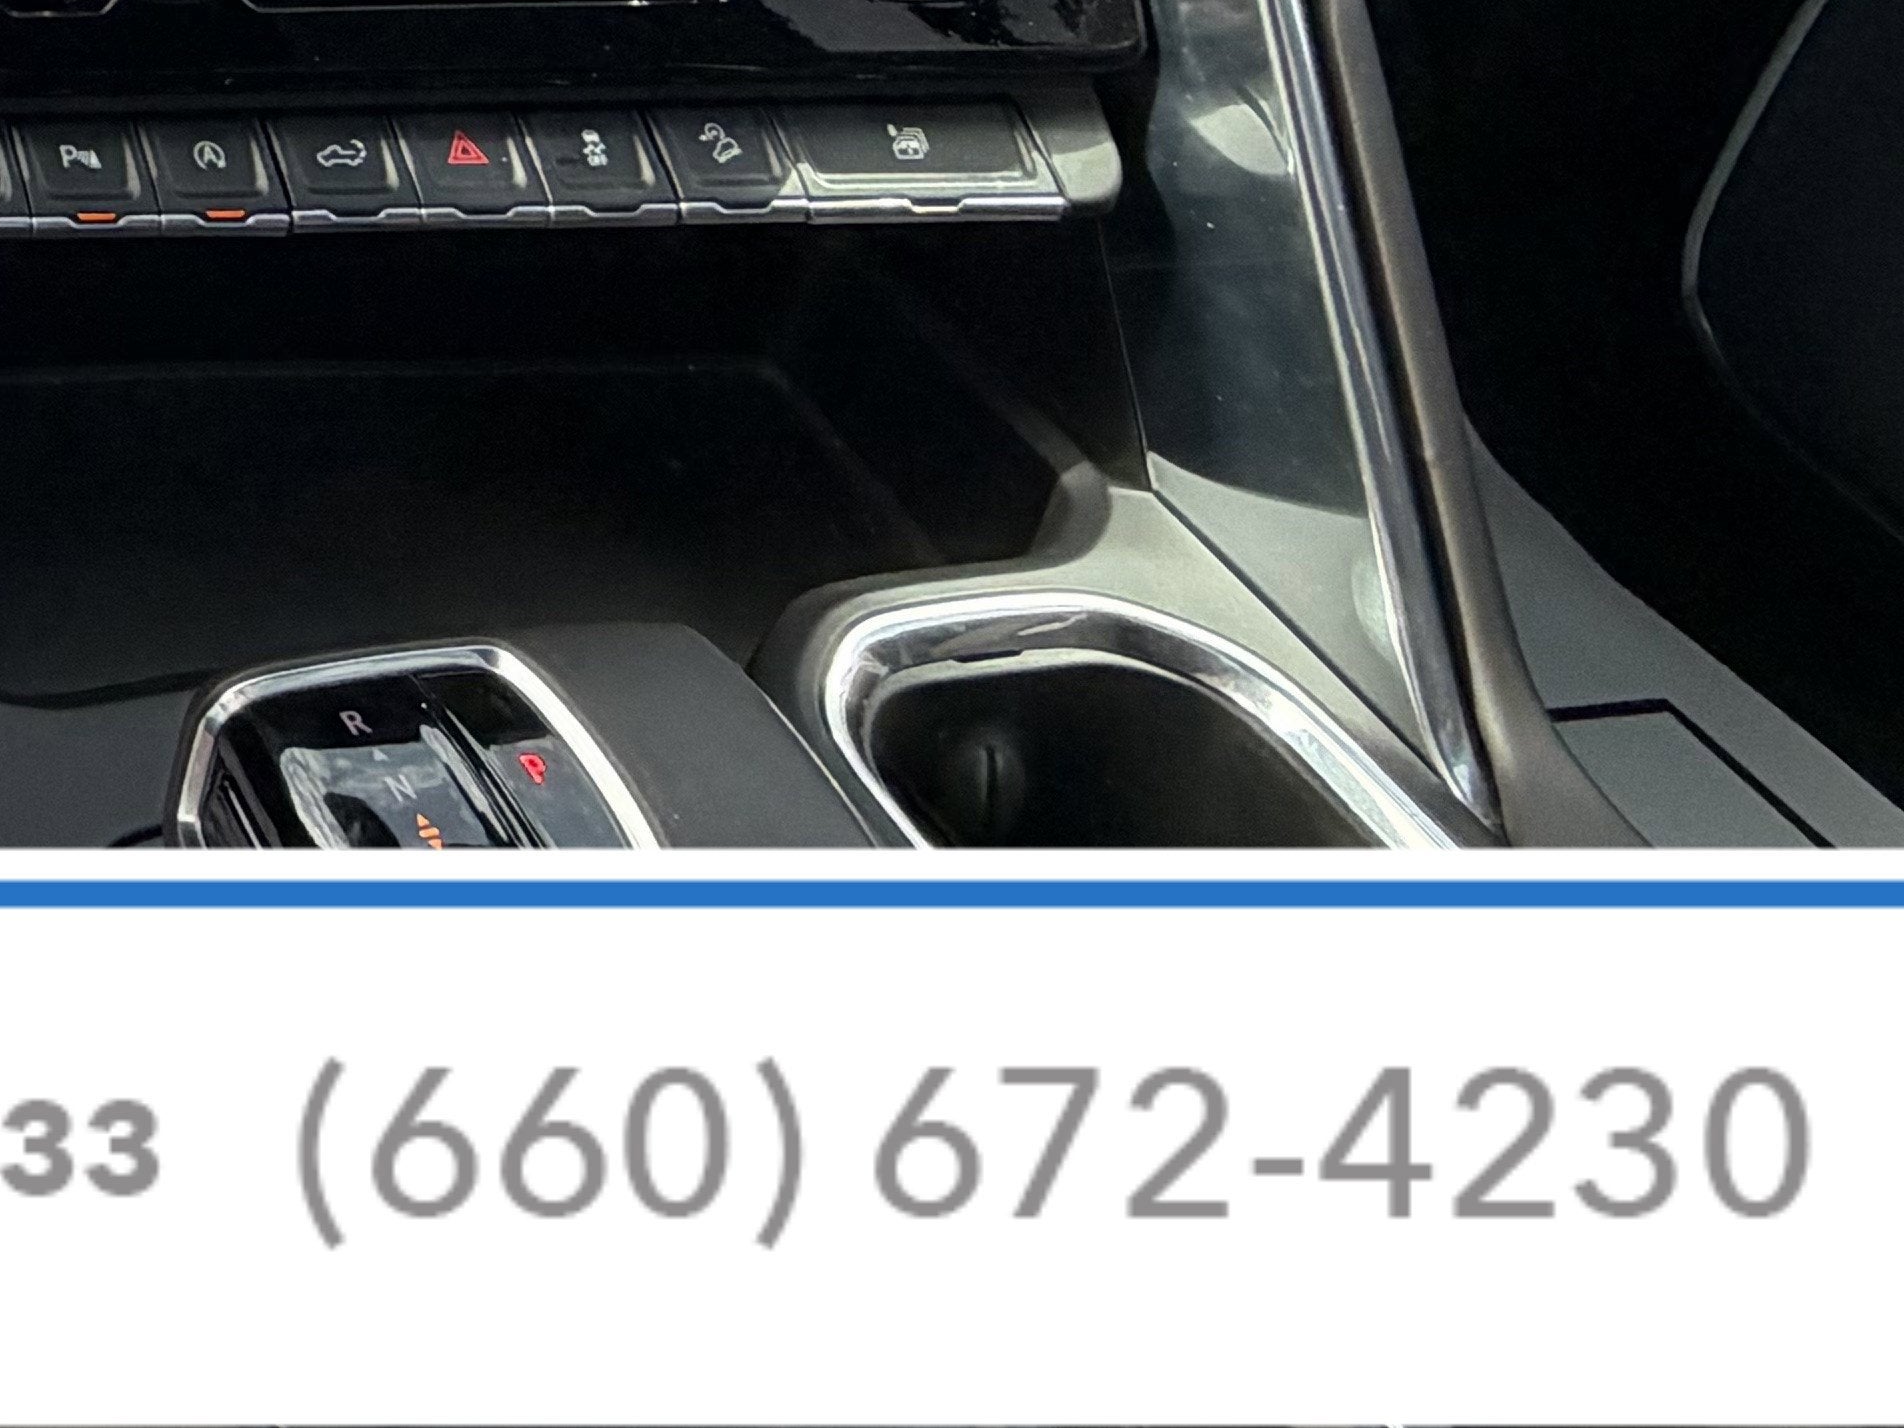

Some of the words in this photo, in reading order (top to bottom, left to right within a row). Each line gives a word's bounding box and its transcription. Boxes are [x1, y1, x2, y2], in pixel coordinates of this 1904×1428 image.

[338, 709, 373, 735] R
[518, 752, 548, 784] P
[383, 774, 418, 803] N
